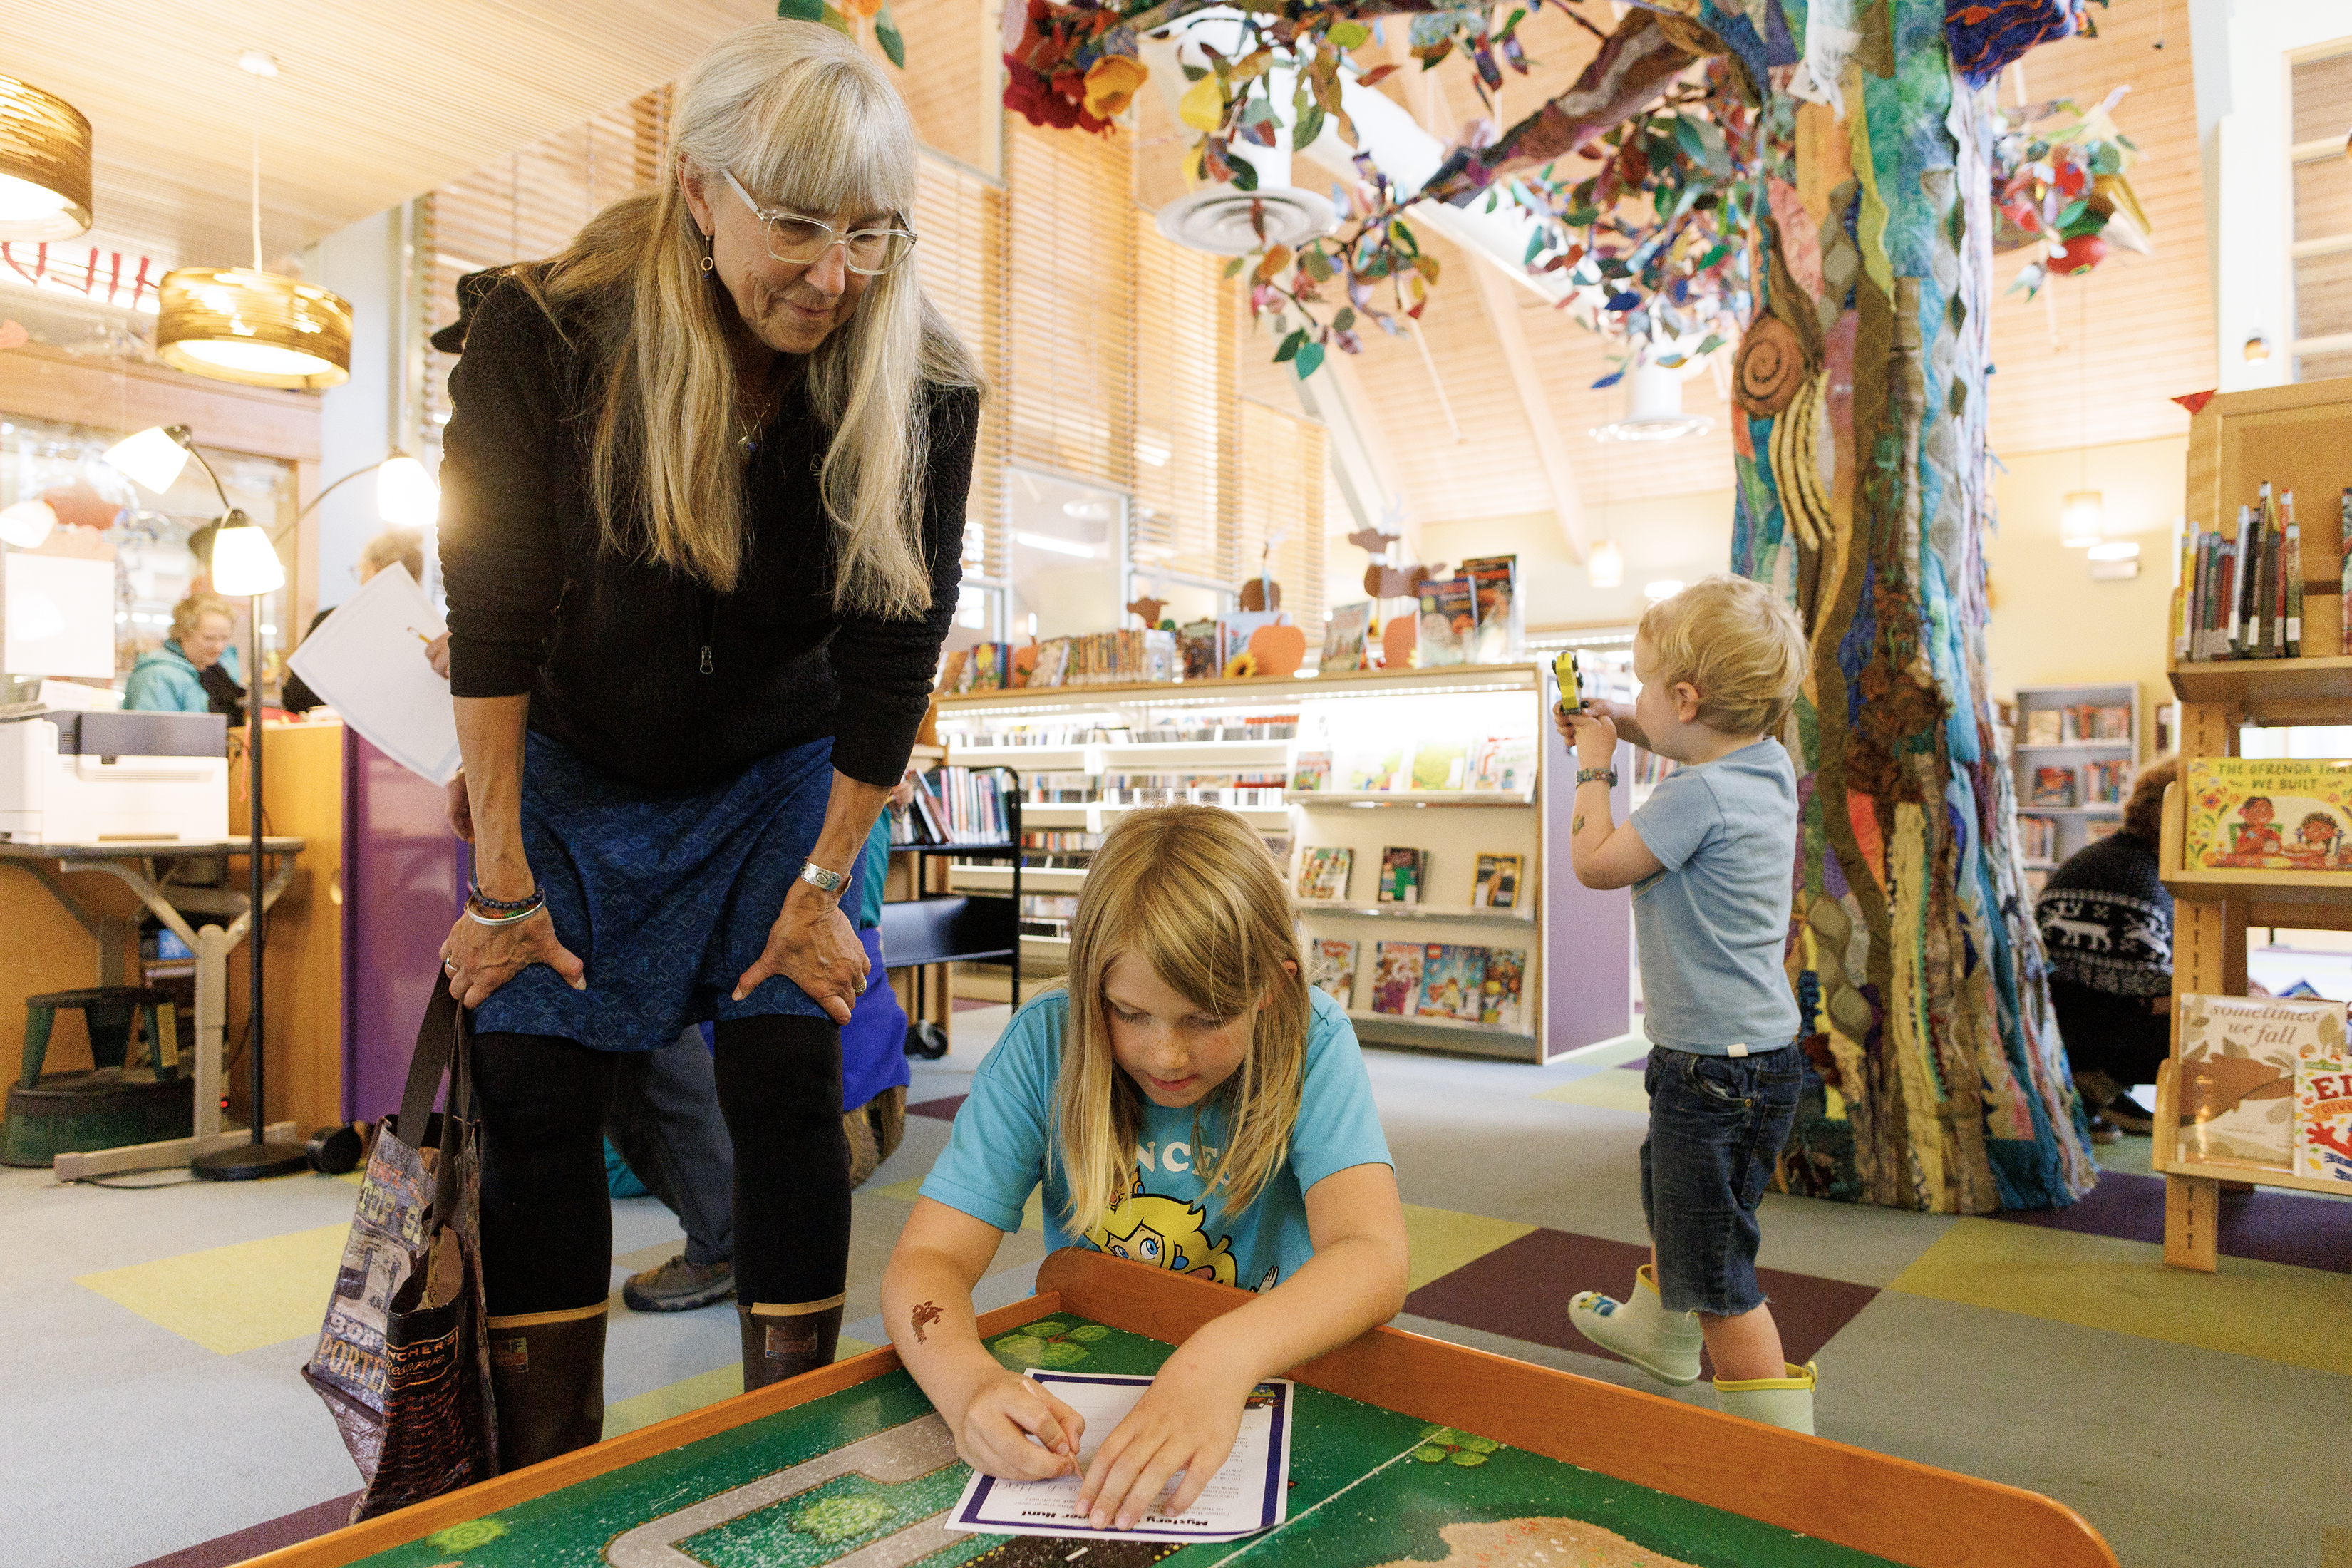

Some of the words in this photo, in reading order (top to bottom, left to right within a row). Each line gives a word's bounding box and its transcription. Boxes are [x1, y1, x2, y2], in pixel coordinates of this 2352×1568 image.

[2219, 763, 2243, 775] THE
[2249, 763, 2312, 775] OFRENDA
[2252, 778, 2273, 790] WE
[2279, 778, 2319, 790] BUILT
[2210, 1004, 2320, 1023] sometimes
[2228, 1023, 2254, 1034] we
[2249, 1024, 2298, 1047] fall
[316, 1332, 386, 1396] PORTE
[1021, 1510, 1056, 1519] Hunt
[1146, 1516, 1208, 1526] Mystery
